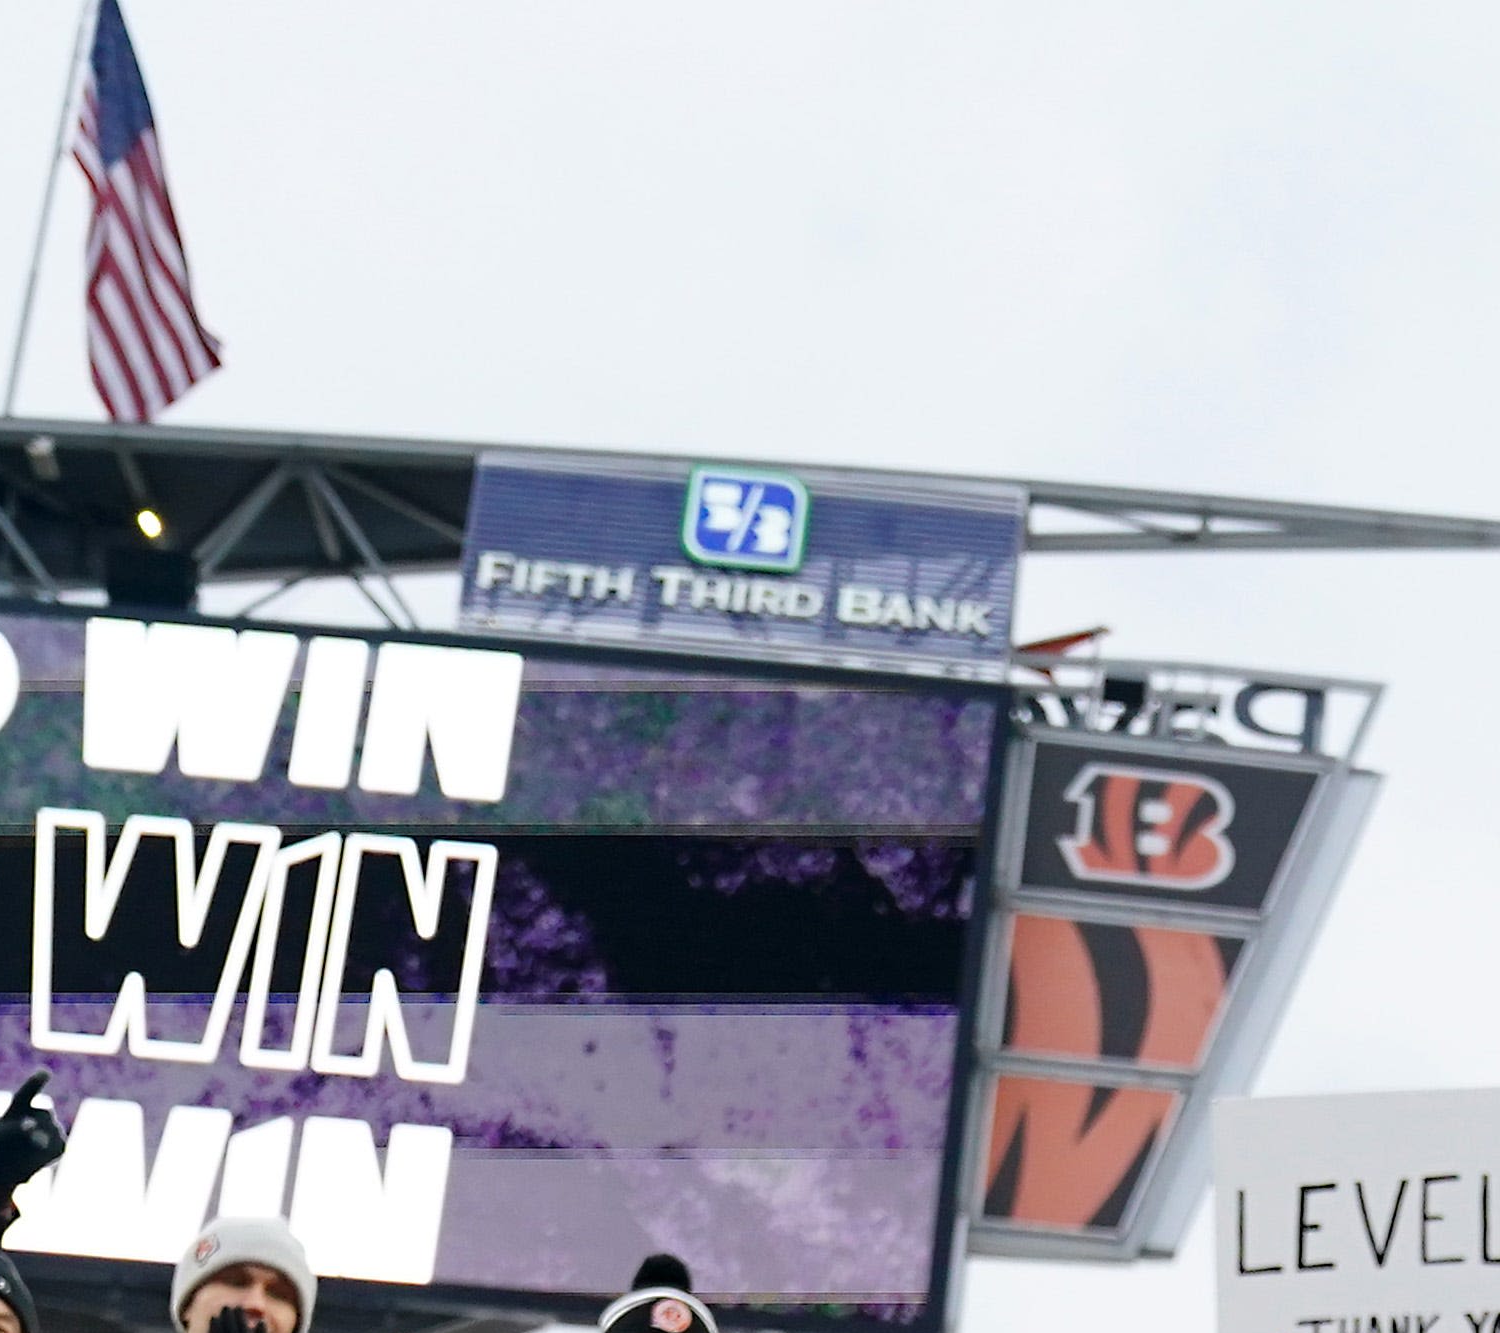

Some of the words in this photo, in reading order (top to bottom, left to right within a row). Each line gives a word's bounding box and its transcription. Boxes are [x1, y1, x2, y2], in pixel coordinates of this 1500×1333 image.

[476, 550, 635, 602] FIFTH
[651, 564, 824, 620] THIRD
[837, 586, 995, 637] BANK
[83, 616, 524, 801] WIN
[31, 806, 498, 1085] WIN
